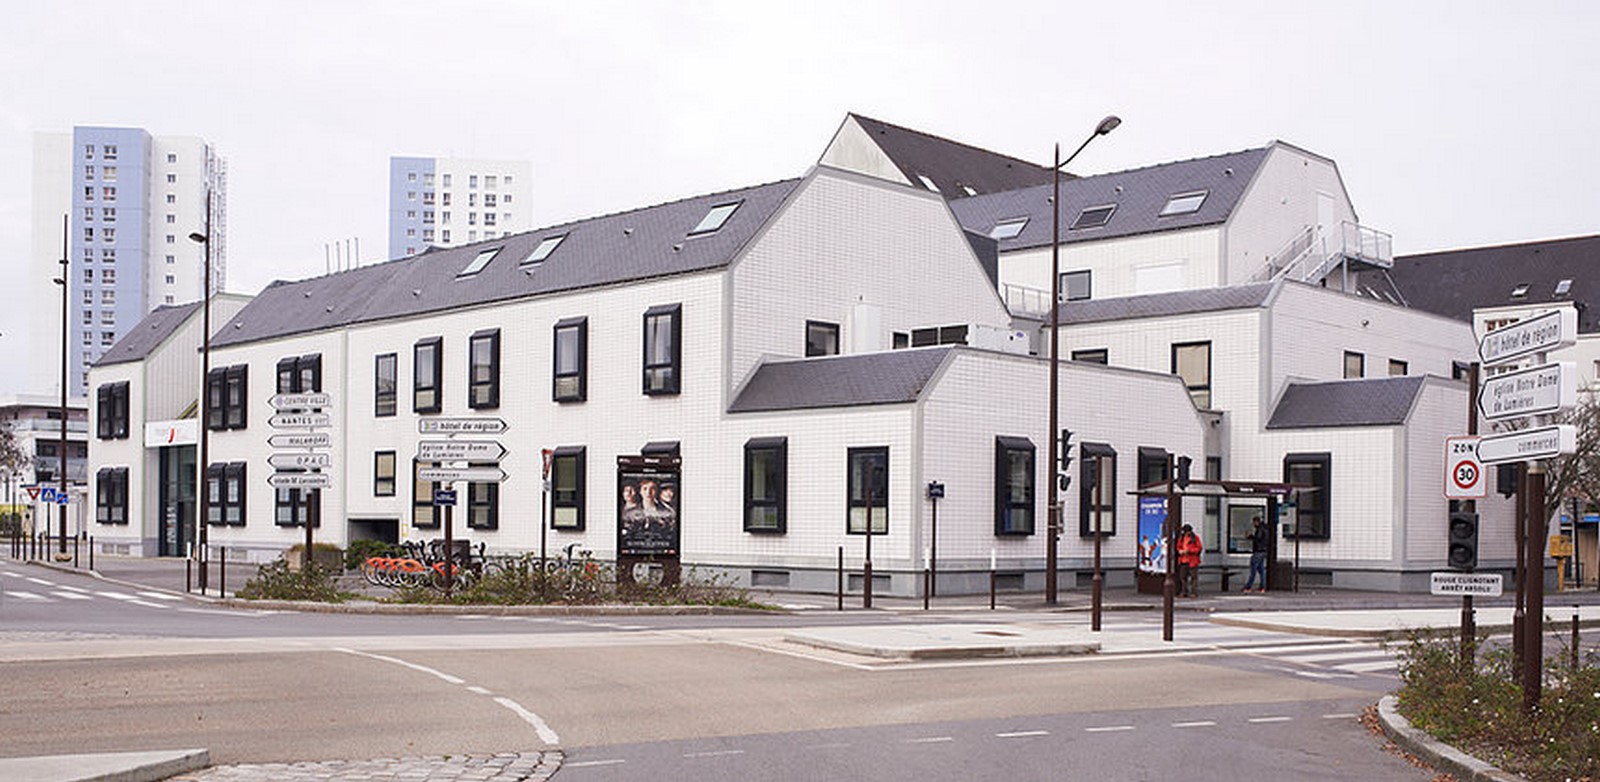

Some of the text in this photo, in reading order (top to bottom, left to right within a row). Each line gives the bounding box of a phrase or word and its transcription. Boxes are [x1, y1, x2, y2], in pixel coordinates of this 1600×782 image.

[1501, 332, 1519, 351] hôtel
[1521, 330, 1531, 347] de
[1538, 374, 1558, 388] Dame
[462, 422, 472, 430] de
[1453, 443, 1474, 453] ZON
[1458, 468, 1475, 481] 30
